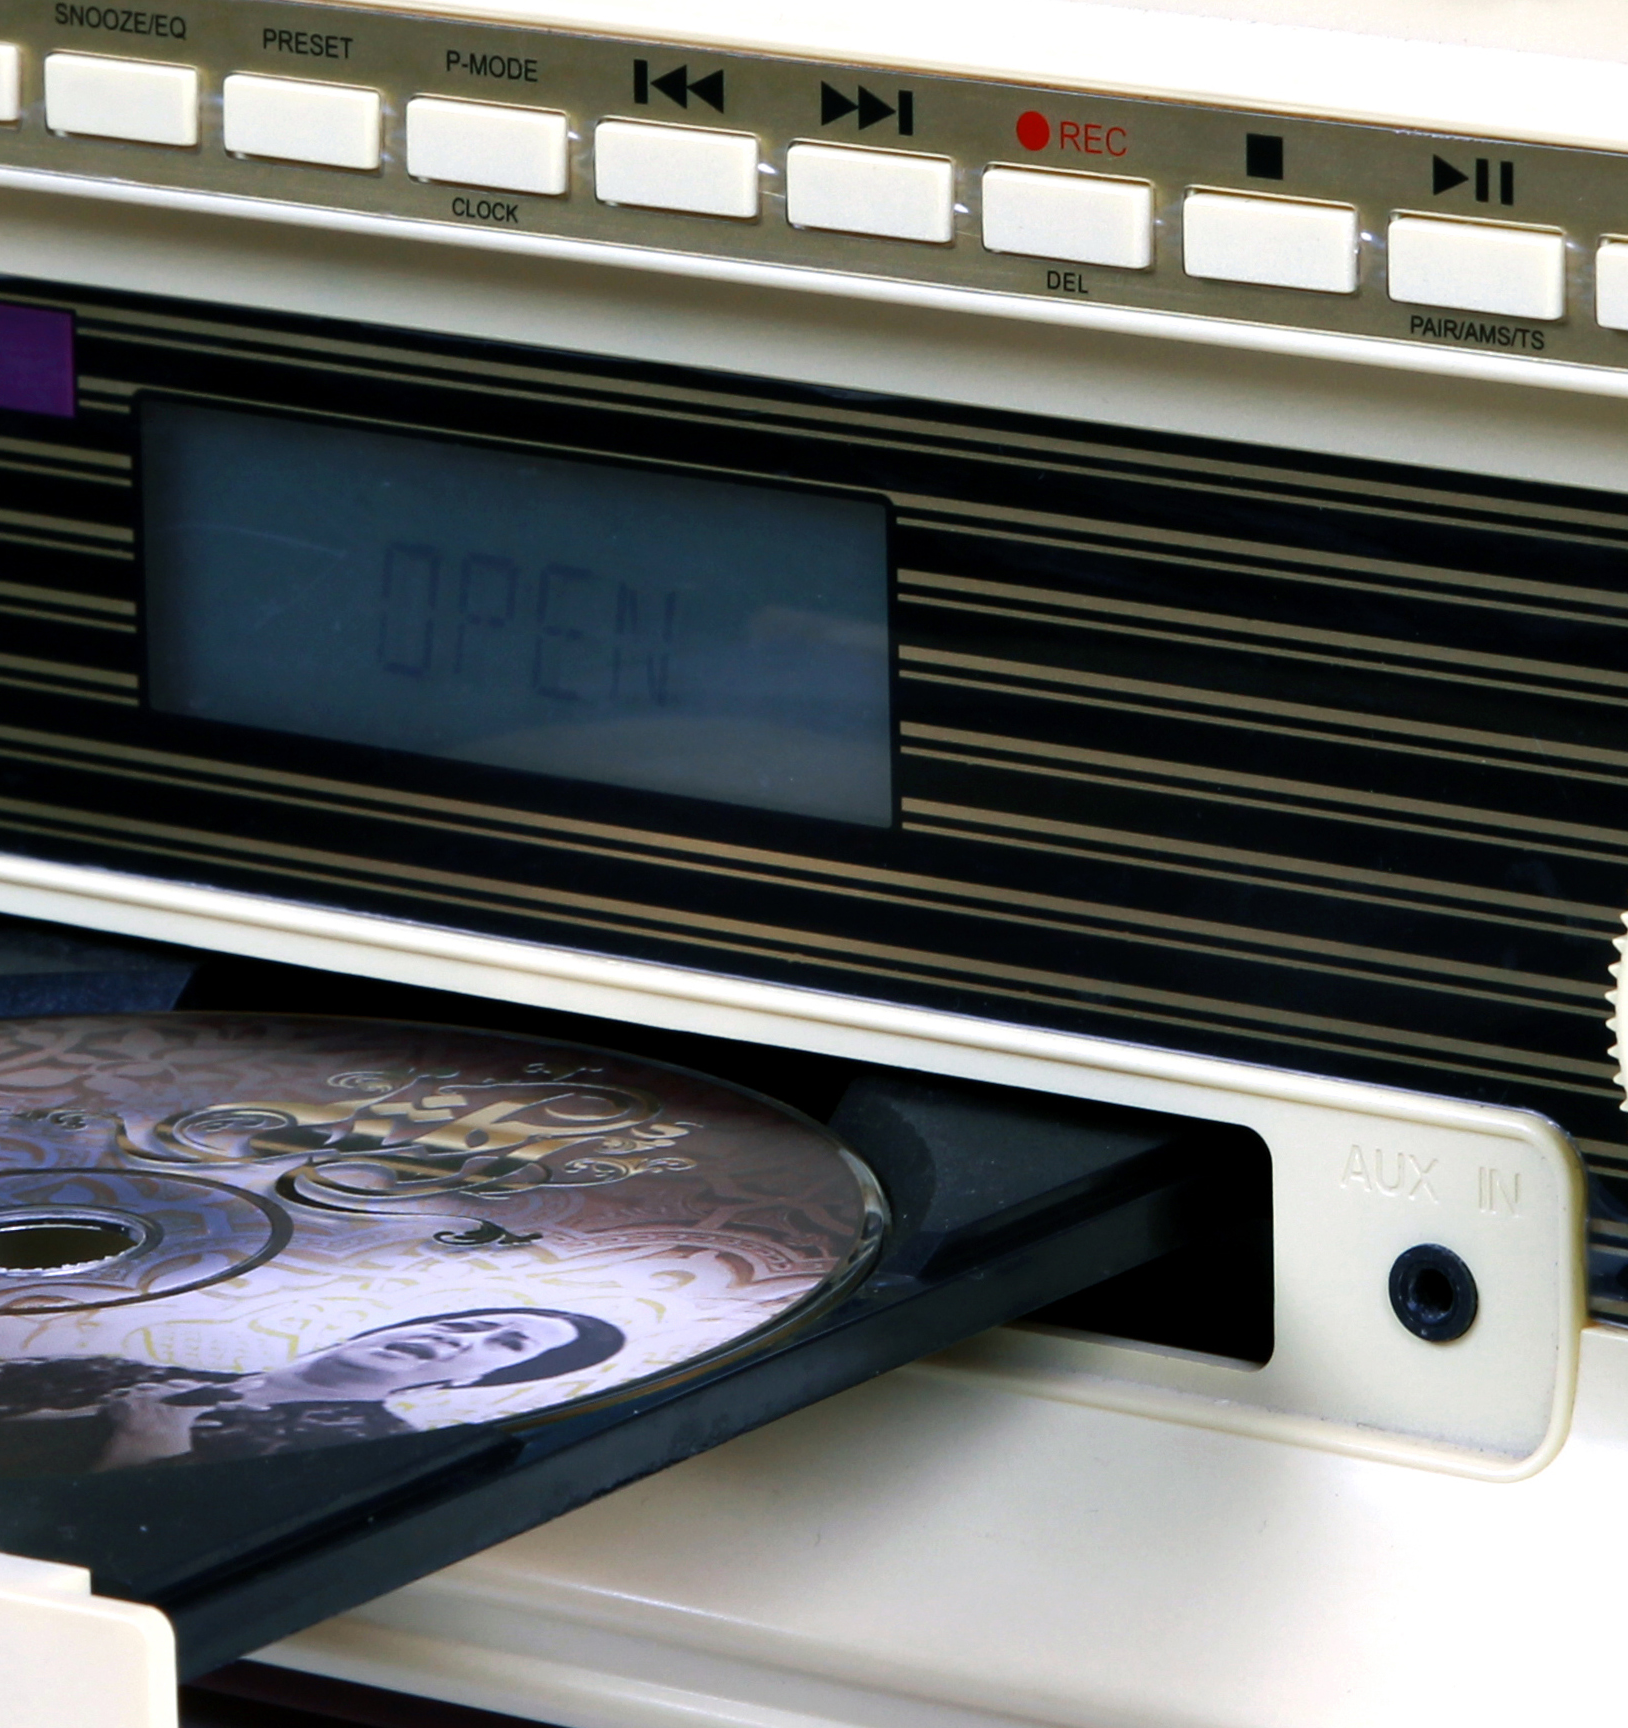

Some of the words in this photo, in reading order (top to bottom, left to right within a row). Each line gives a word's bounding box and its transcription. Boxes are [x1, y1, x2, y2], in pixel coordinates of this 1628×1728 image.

[53, 2, 188, 41] SNOOZE/EQ
[262, 27, 354, 61] PRESET
[445, 49, 539, 84] P-MODE
[1058, 120, 1129, 158] REC
[451, 196, 520, 224] CLOCK
[1046, 269, 1090, 295] DEL
[1409, 314, 1546, 352] PAIR/AMS/TS
[377, 539, 679, 709] OPEN
[1339, 1143, 1441, 1205] AUX
[1476, 1165, 1524, 1219] IN
